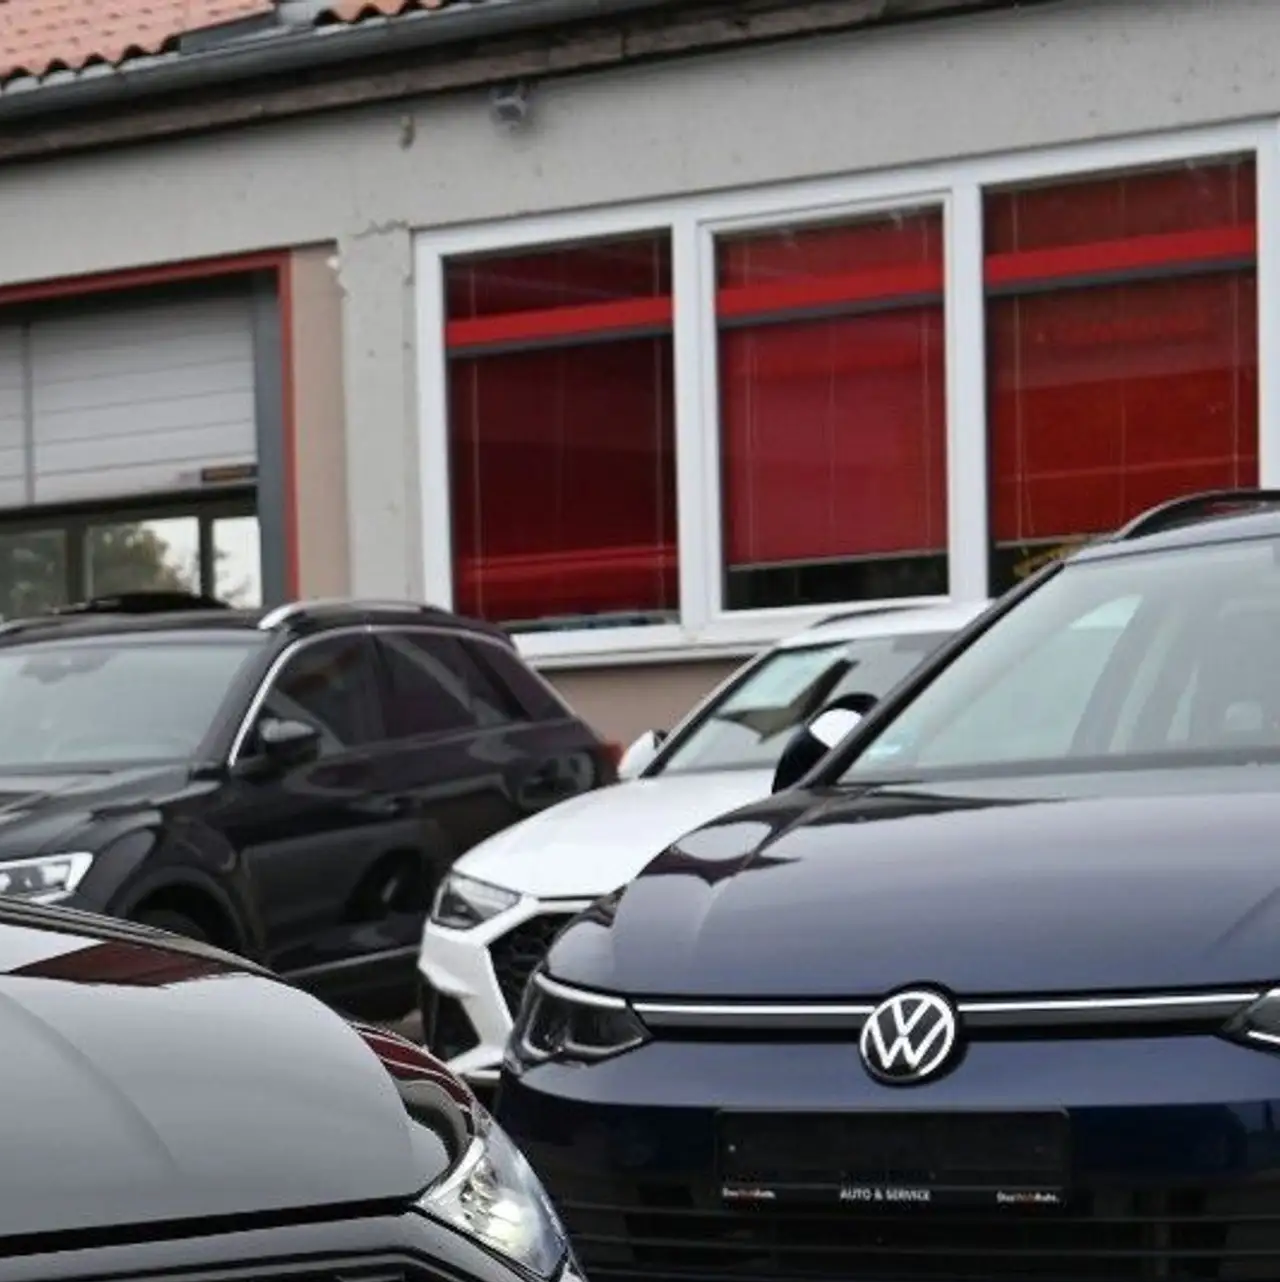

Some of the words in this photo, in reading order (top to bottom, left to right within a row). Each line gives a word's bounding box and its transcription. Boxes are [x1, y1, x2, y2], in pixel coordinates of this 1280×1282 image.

[866, 995, 951, 1070] VW
[839, 1187, 872, 1201] AUTO
[886, 1188, 930, 1201] SERVICE
